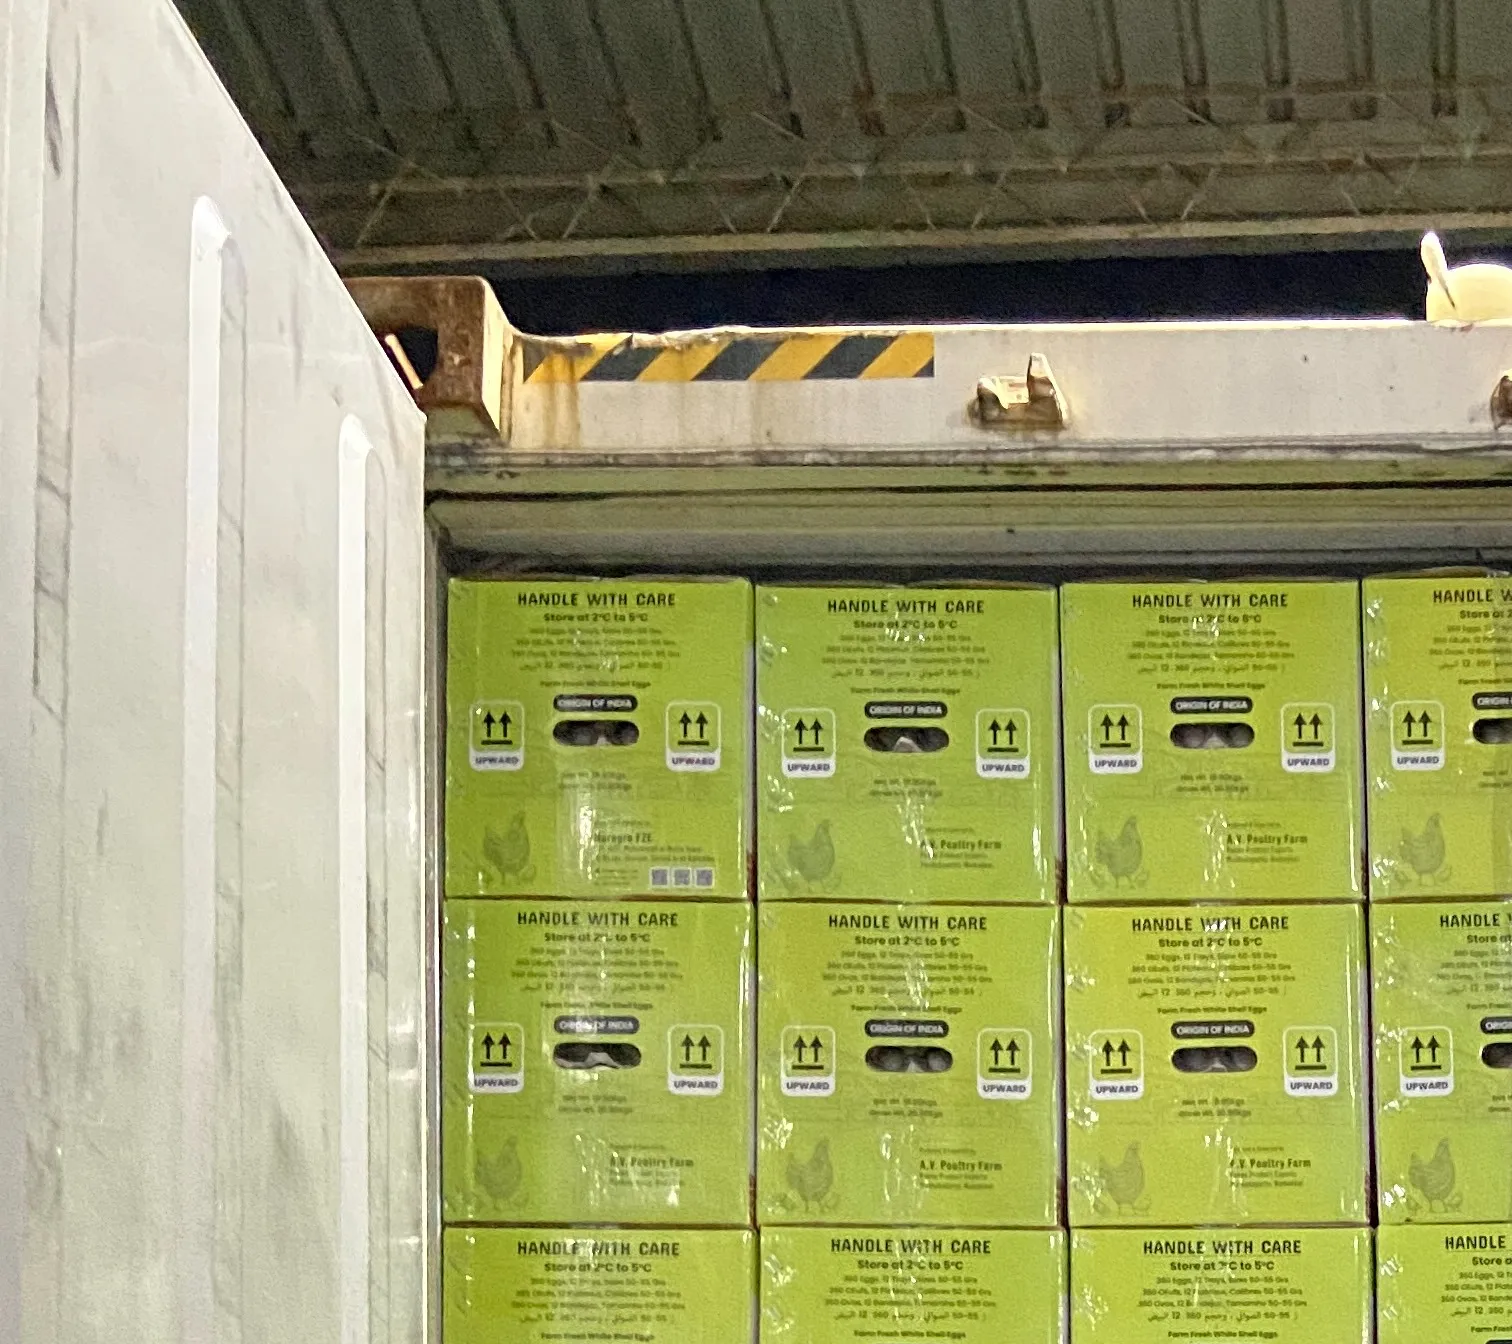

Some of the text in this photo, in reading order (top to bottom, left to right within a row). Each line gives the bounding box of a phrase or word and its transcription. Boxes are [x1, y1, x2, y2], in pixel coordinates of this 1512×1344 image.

[1132, 594, 1288, 609] HANDLE WITH CARE
[1433, 588, 1494, 603] HANDLE
[828, 599, 985, 614] HANDLE WITH CARE
[1094, 758, 1138, 769] UPWARD
[829, 915, 988, 930] HANDLE WITH CARE
[1158, 938, 1187, 948] Store
[1191, 938, 1205, 948] at
[1228, 938, 1241, 948] to
[983, 1084, 1027, 1095] UPWARD
[1095, 1084, 1139, 1095] UPWARD
[920, 1159, 1003, 1174] A.V. Poultry Farm
[1445, 1235, 1506, 1249] HANDLE
